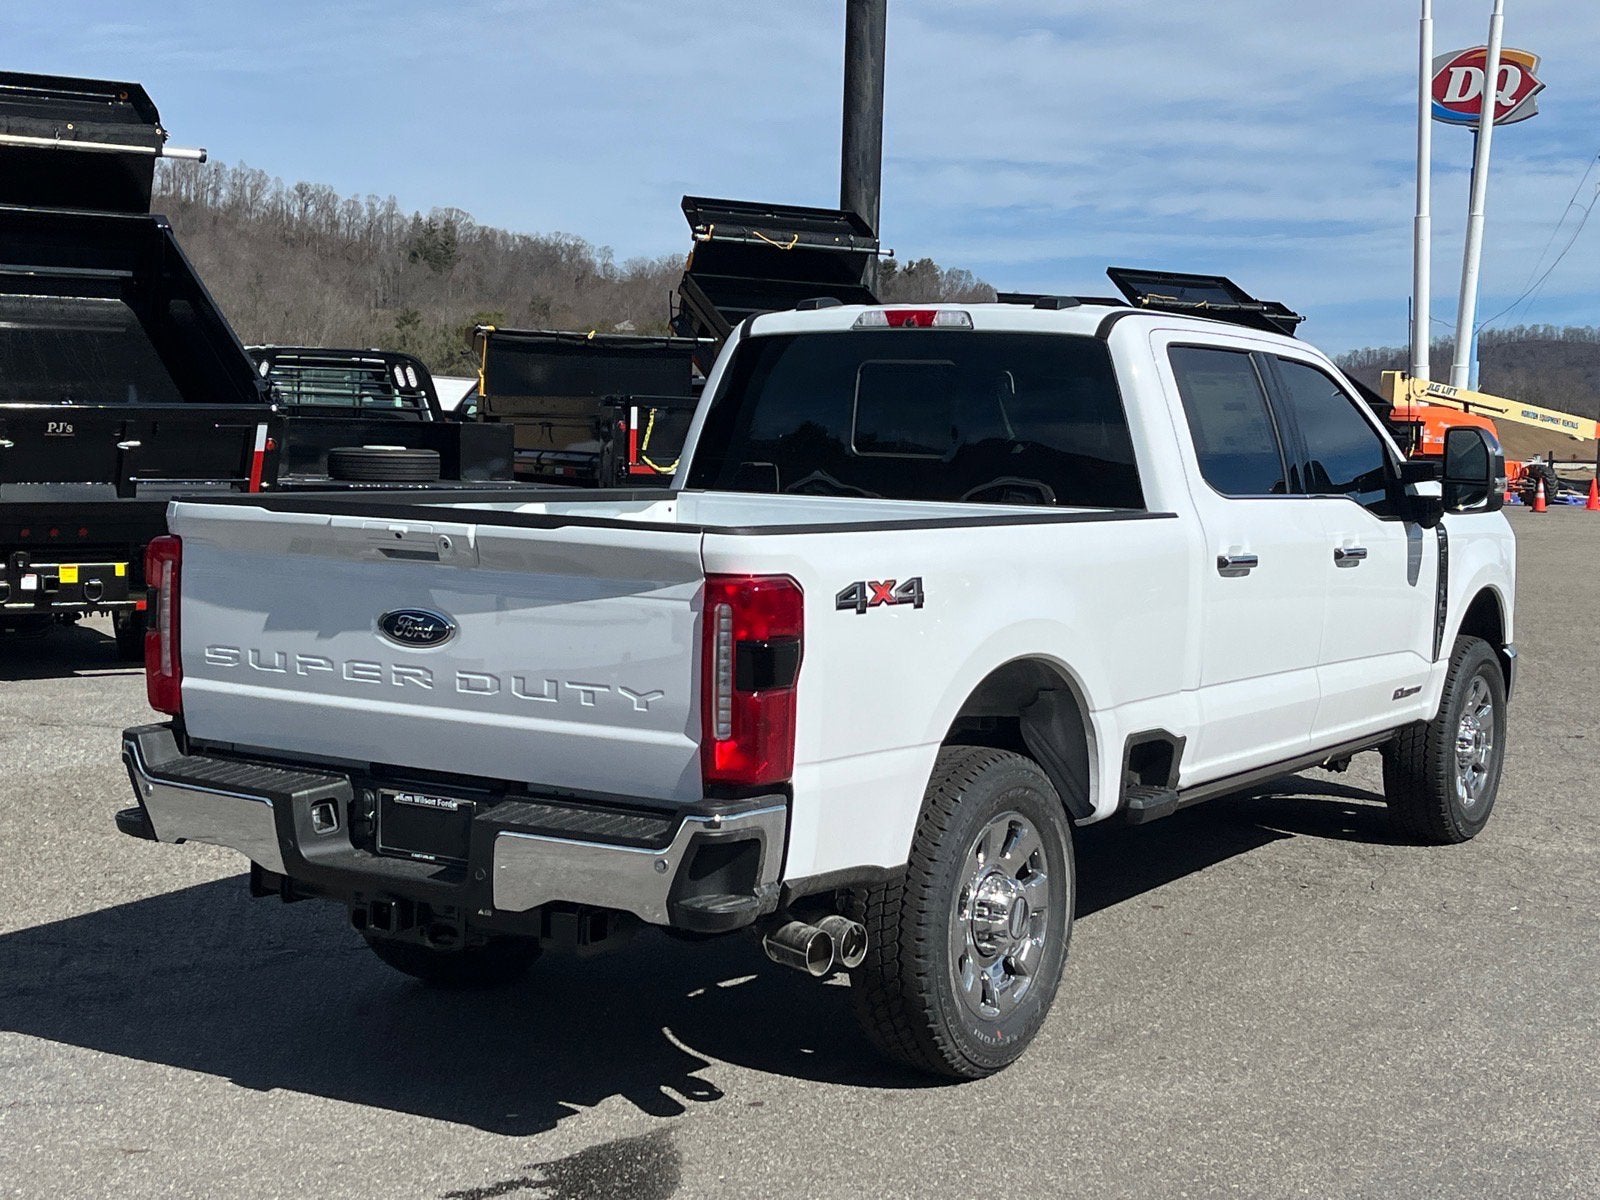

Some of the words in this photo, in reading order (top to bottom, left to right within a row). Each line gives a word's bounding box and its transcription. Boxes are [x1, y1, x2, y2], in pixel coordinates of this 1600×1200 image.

[1443, 64, 1521, 106] DQ
[1426, 382, 1441, 393] JLG
[1441, 385, 1458, 396] LIFT
[47, 421, 73, 433] PJ's
[393, 614, 435, 639] Ford
[204, 644, 434, 690] SUPER
[455, 669, 666, 713] DUTY
[413, 795, 436, 806] Wilson
[437, 798, 453, 809] Ford
